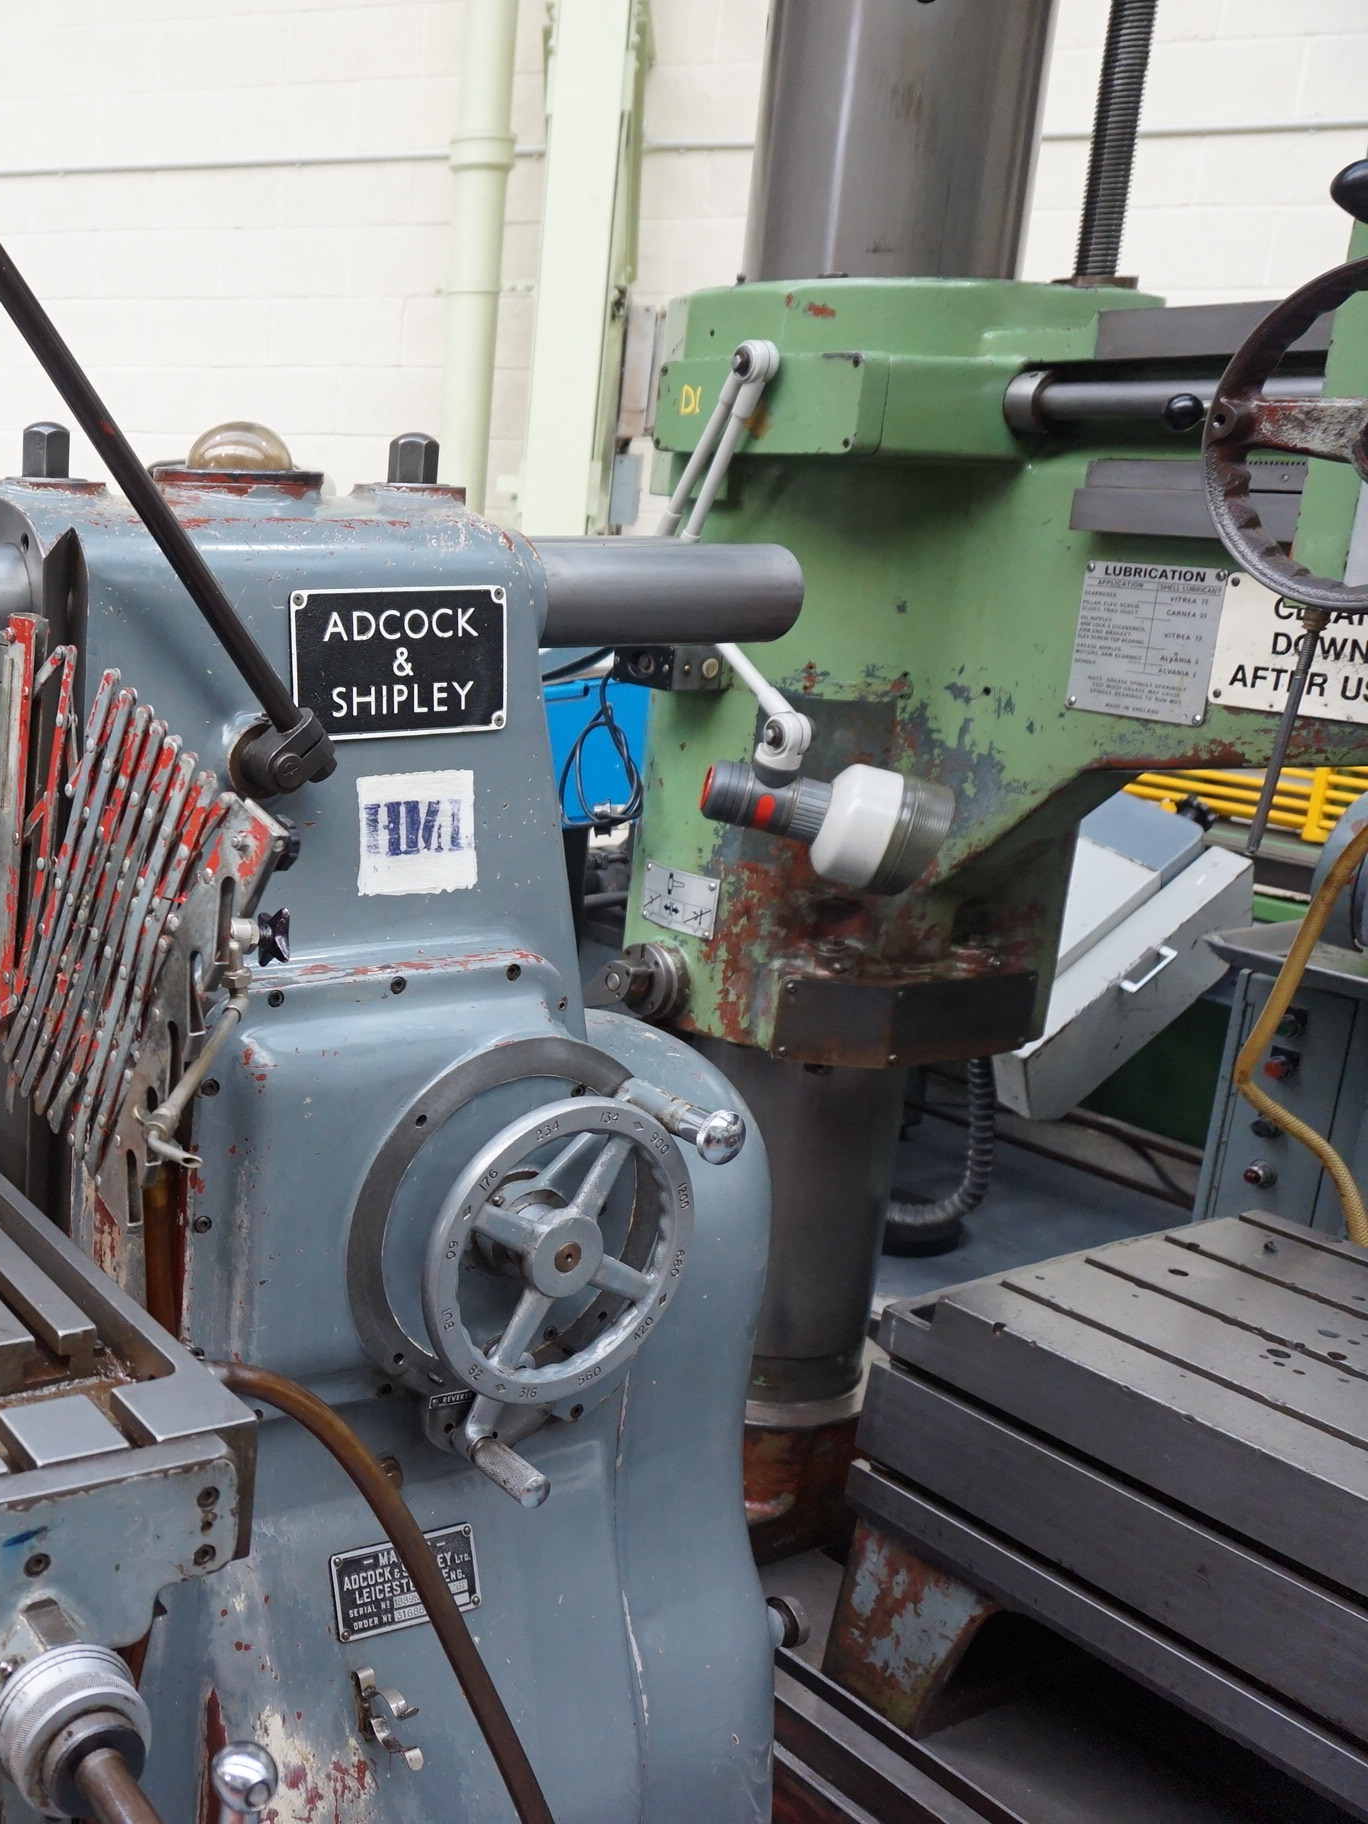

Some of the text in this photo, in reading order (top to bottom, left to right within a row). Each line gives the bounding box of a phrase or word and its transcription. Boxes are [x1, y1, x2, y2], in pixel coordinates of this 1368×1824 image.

[1097, 579, 1144, 588] APPLICATION
[1104, 565, 1207, 582] LUBRICATION
[1160, 583, 1222, 595] SHELL LUBRICANT
[322, 607, 479, 642] ADCOCK
[392, 647, 414, 677] &
[1228, 664, 1329, 697] AFTR
[332, 681, 474, 718] SHIPLEY
[599, 1111, 620, 1125] 134
[535, 1120, 561, 1142] 234
[650, 1132, 670, 1155] 900
[478, 1168, 499, 1191] 176
[677, 1182, 690, 1210] 1200
[670, 1249, 686, 1277] 680
[633, 1316, 654, 1342] 420
[468, 1364, 483, 1381] 82
[577, 1366, 602, 1386] 560
[343, 1566, 392, 1592] ADCOCK
[394, 1568, 400, 1579] &
[349, 1604, 377, 1618] SERIAL
[353, 1617, 379, 1631] ORDER
